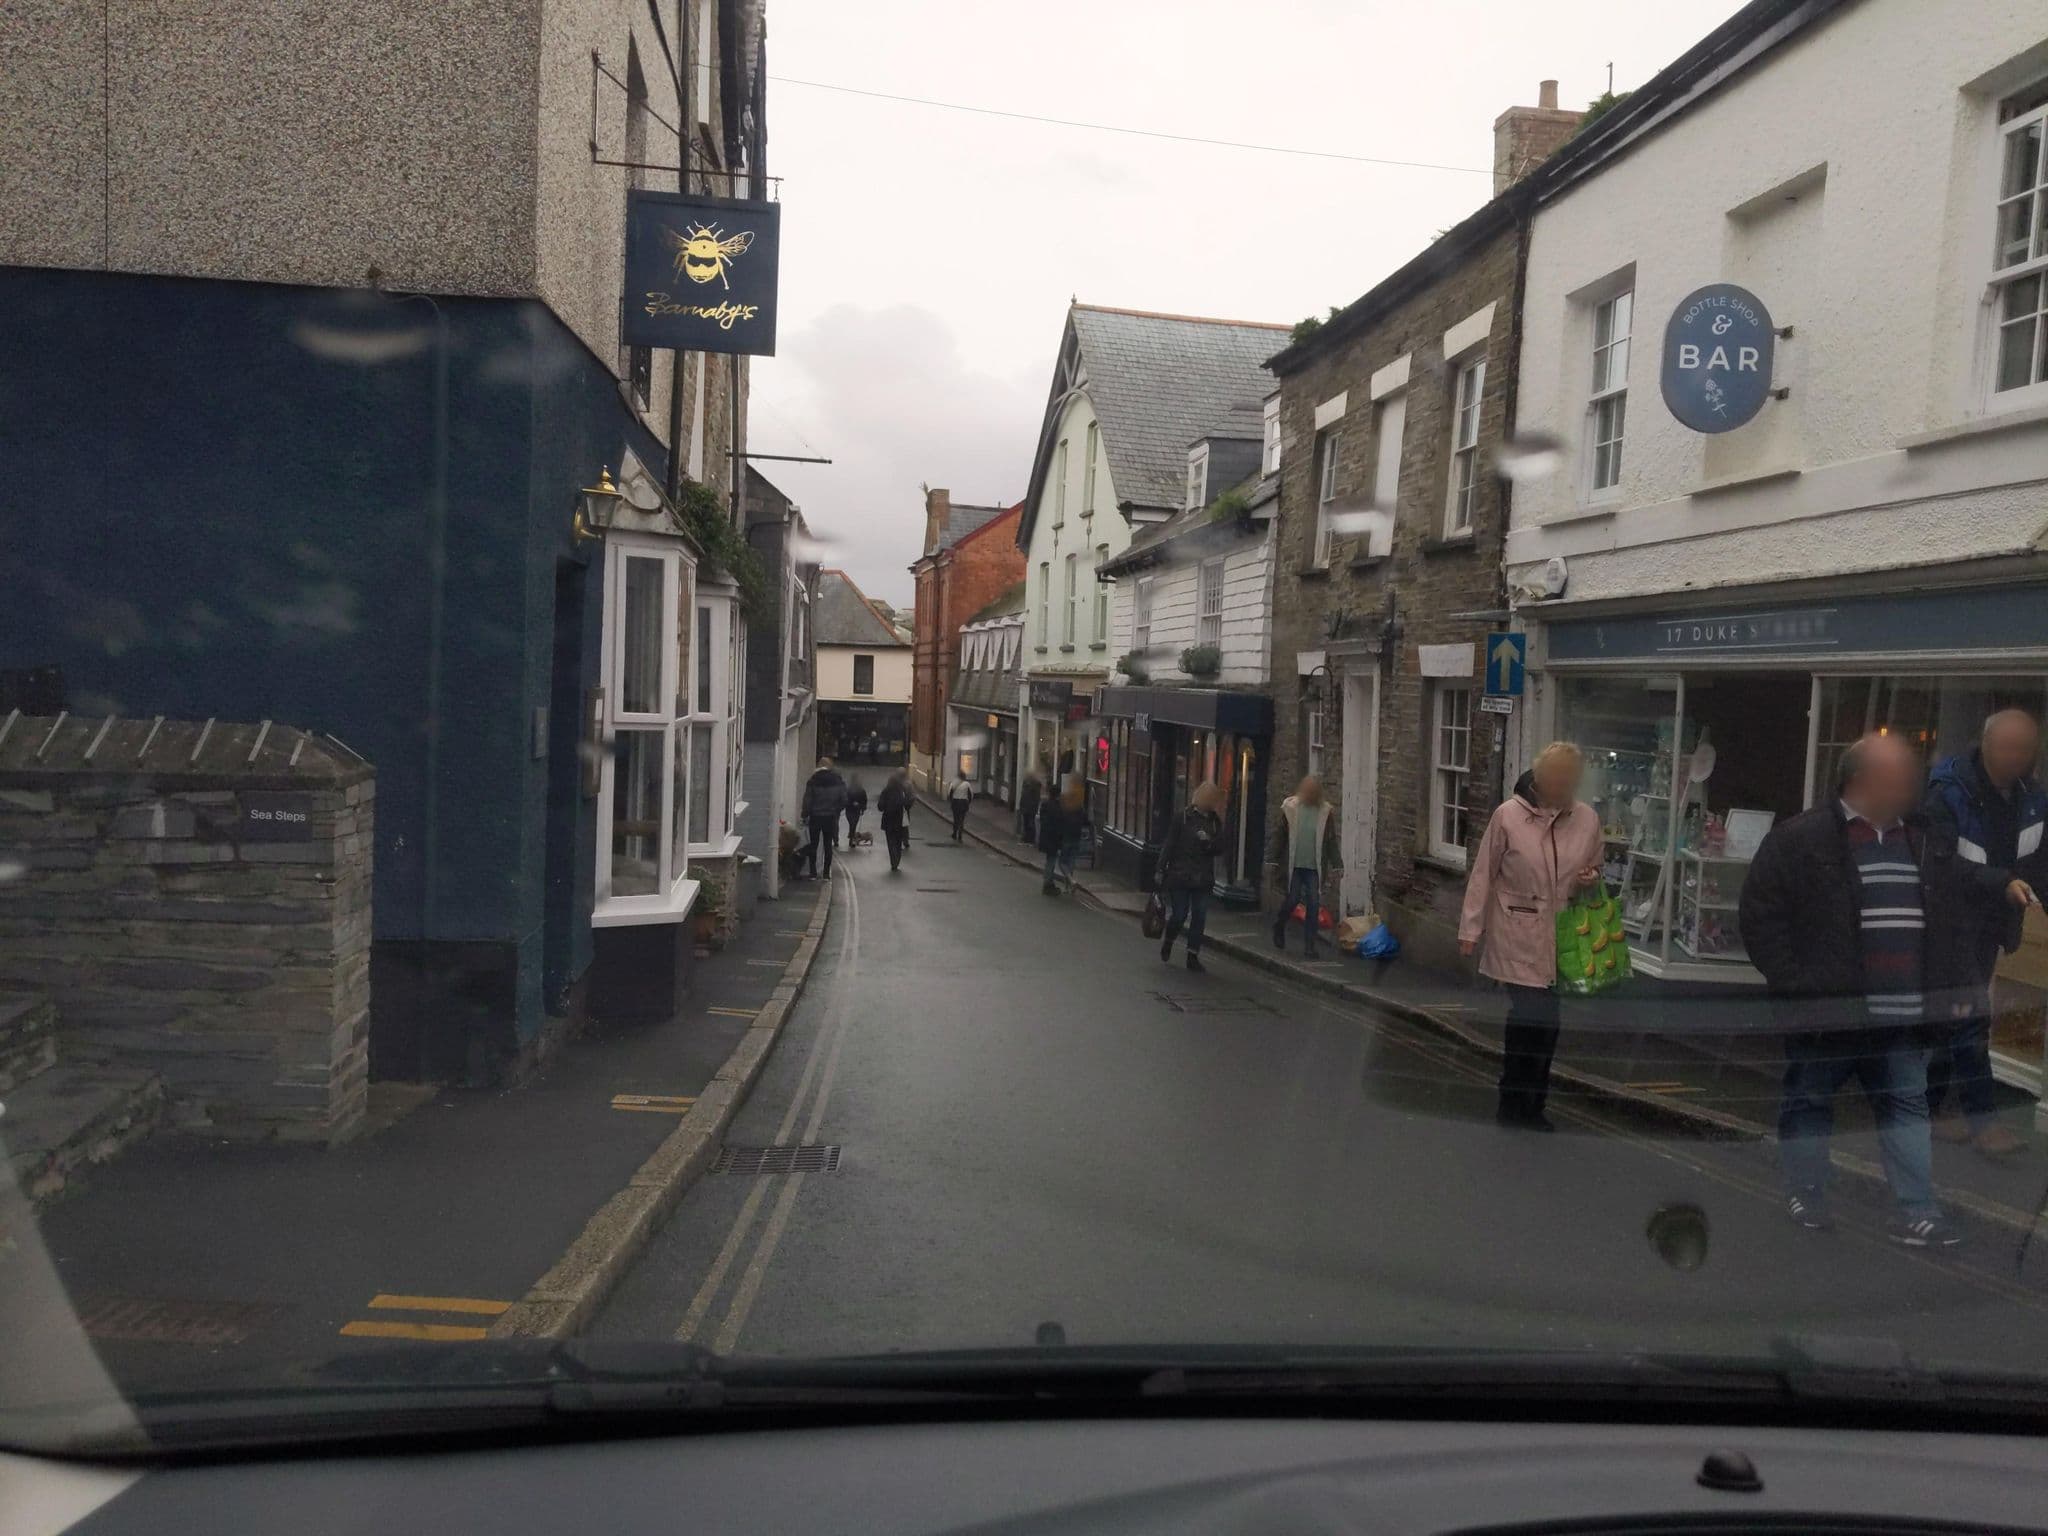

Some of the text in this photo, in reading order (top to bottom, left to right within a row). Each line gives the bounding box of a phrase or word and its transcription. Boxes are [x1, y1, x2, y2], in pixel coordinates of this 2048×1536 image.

[645, 292, 759, 330] Barnaby's
[1683, 296, 1759, 327] BOTTLE SHOP
[1711, 314, 1733, 335] &
[1678, 344, 1760, 372] BAR
[1667, 628, 1681, 642] 17
[1693, 625, 1737, 641] DUKE
[250, 809, 306, 822] Sea Steps
